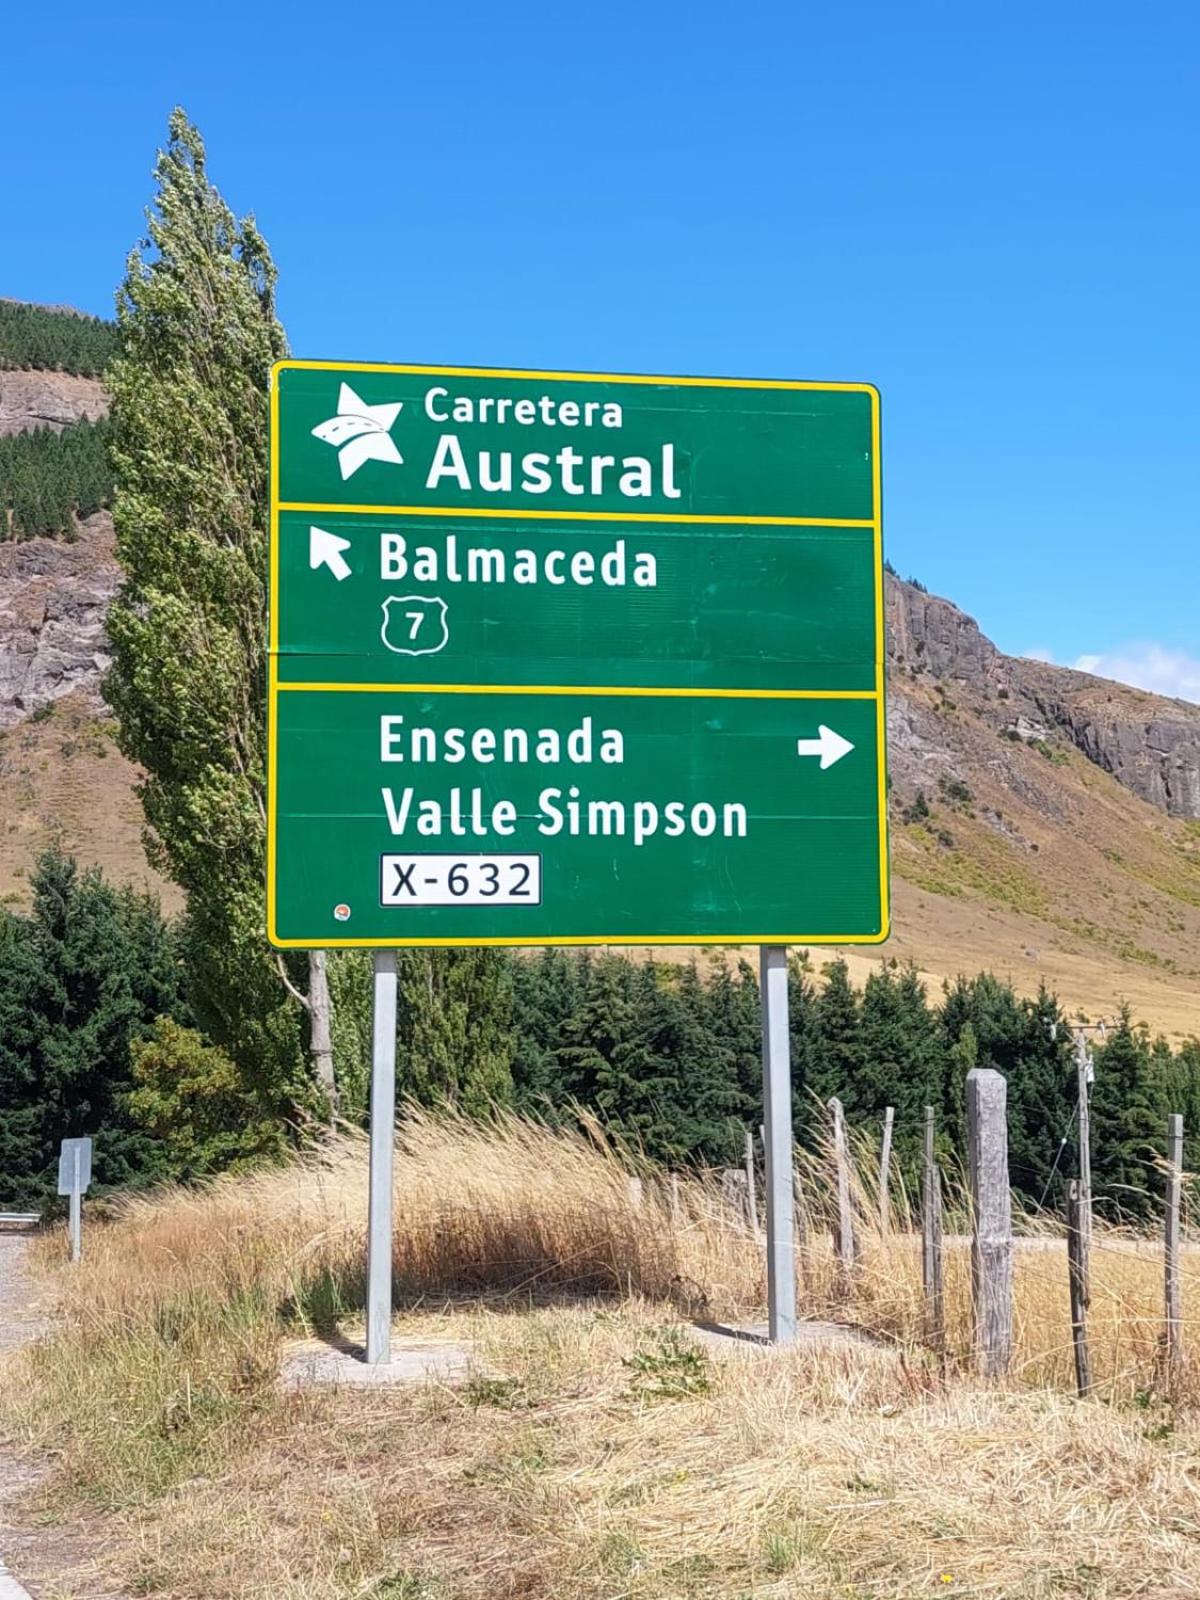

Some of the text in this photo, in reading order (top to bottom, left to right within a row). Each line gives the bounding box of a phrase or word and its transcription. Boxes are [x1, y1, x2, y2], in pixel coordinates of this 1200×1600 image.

[424, 387, 622, 428] Carretera
[425, 434, 681, 498] Austral
[380, 533, 657, 587] Balmaceda
[405, 612, 424, 639] 7
[380, 715, 624, 763] Ensenada
[381, 787, 747, 846] Valle Simpson
[391, 863, 532, 897] X-632
